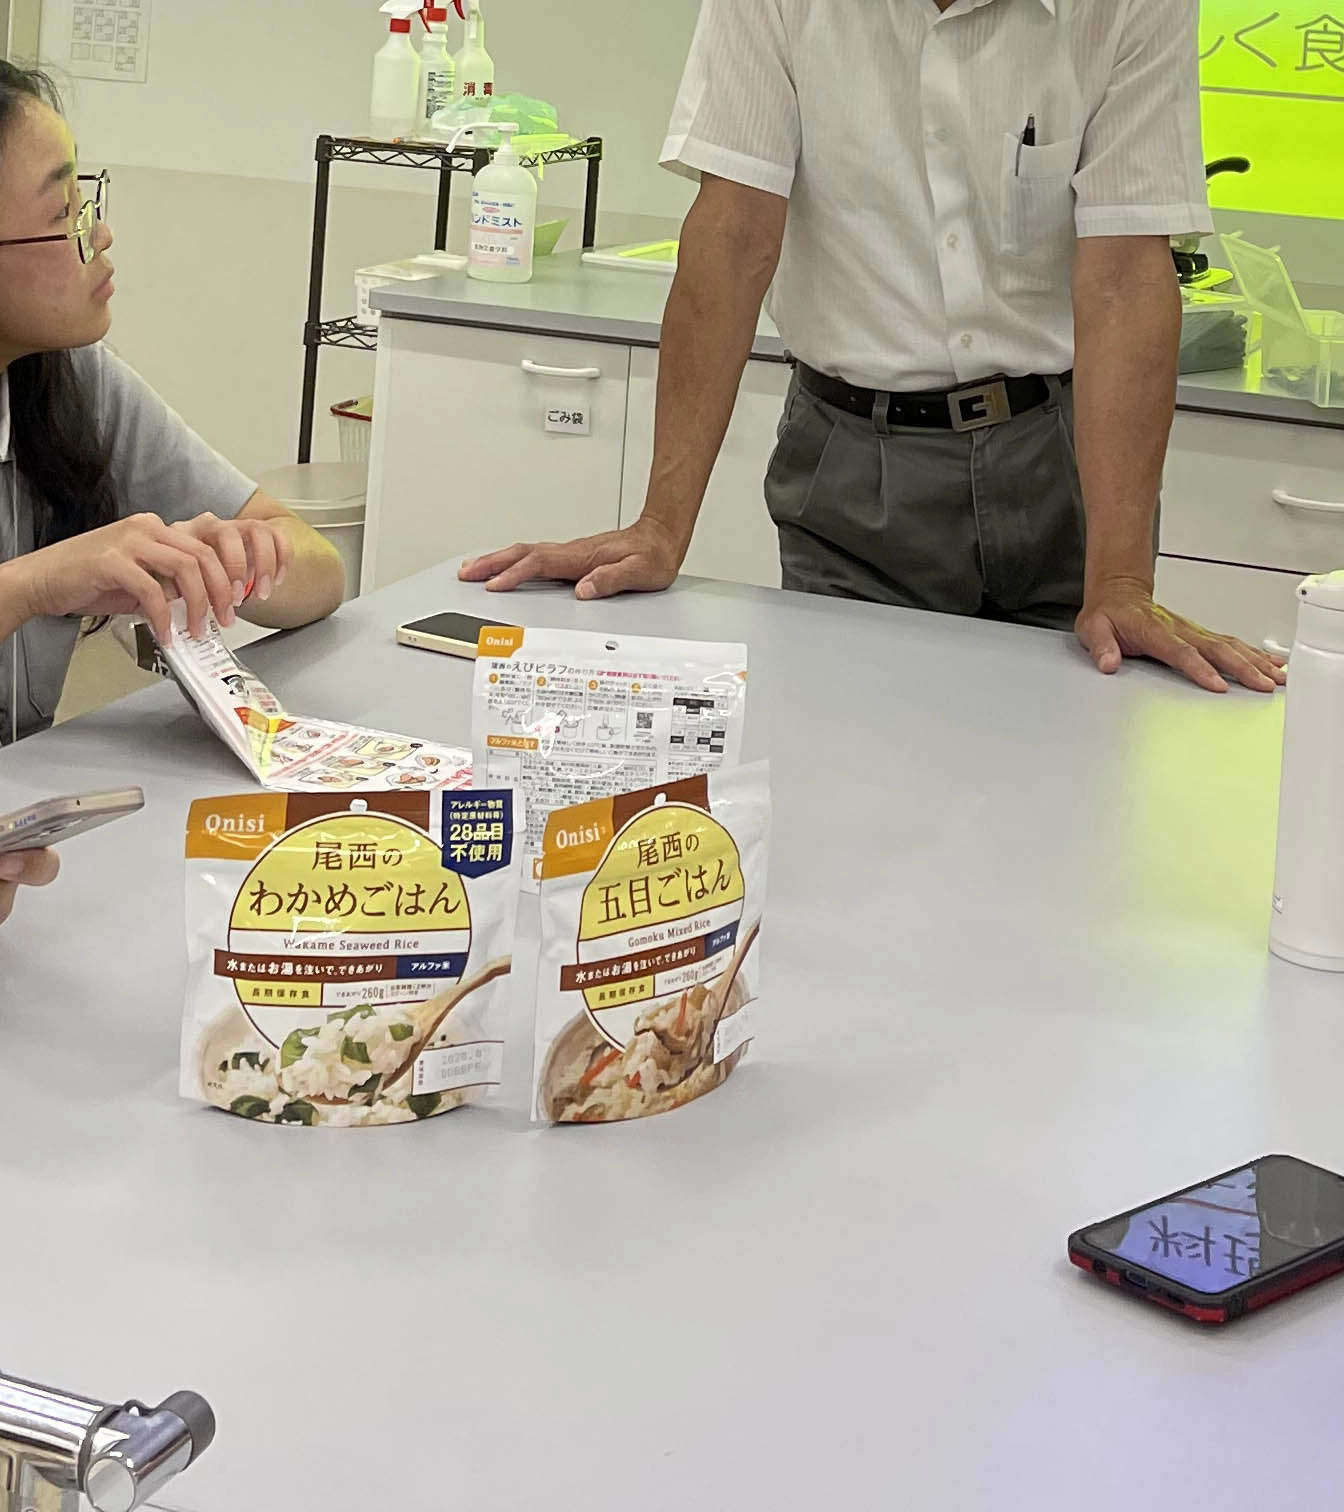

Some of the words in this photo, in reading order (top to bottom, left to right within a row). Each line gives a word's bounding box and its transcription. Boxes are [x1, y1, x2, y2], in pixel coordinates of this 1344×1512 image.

[205, 813, 265, 833] Onisi
[450, 822, 503, 841] 28品目
[556, 822, 600, 849] Onisi
[312, 841, 403, 871] 尾西の
[450, 843, 503, 863] 不使用
[637, 831, 700, 868] 尾西の
[249, 879, 460, 917] わかめごはん
[597, 859, 732, 925] 五目ごはん
[339, 938, 390, 950] Seaweed
[394, 938, 419, 949] Rice
[628, 931, 664, 948] Gomoku
[667, 923, 693, 940] Mixed
[694, 919, 712, 933] Rice
